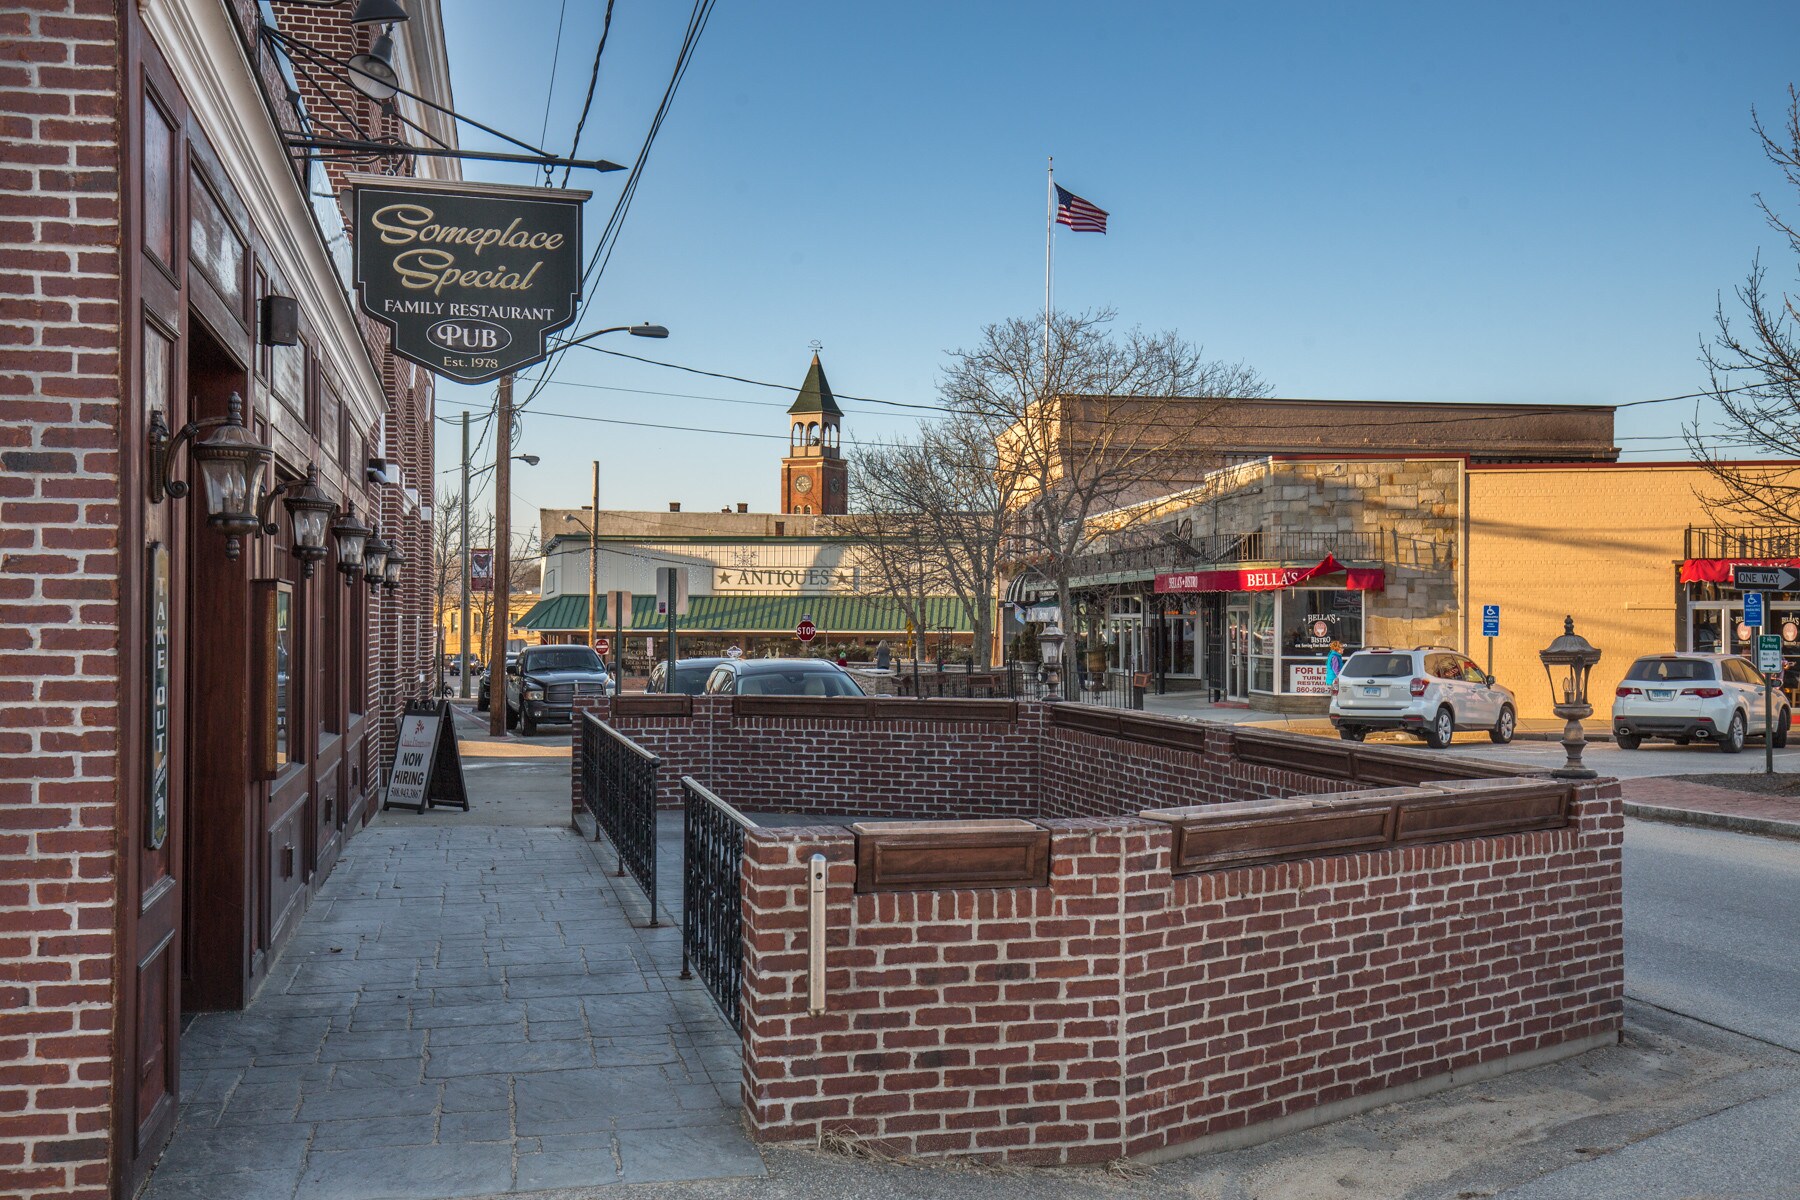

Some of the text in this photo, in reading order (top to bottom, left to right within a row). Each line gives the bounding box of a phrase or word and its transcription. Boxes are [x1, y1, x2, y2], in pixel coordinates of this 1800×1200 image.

[371, 203, 564, 256] Someplace
[392, 248, 544, 297] Special
[384, 299, 555, 321] FAMILY RESTAURANT
[436, 323, 498, 348] PUB
[443, 356, 498, 369] Est. 1978
[737, 569, 829, 588] ANTIQUES
[1247, 571, 1298, 587] BELLA'S
[1739, 572, 1780, 583] ONE WAY
[156, 577, 166, 669] TAKE
[1307, 613, 1336, 624] BELLA'S
[797, 626, 815, 635] STOP
[1295, 667, 1328, 675] FOR LE
[1296, 686, 1332, 694] 860-928-7
[156, 687, 165, 753] OUT
[402, 752, 424, 767] NOW
[393, 770, 425, 786] HIRING
